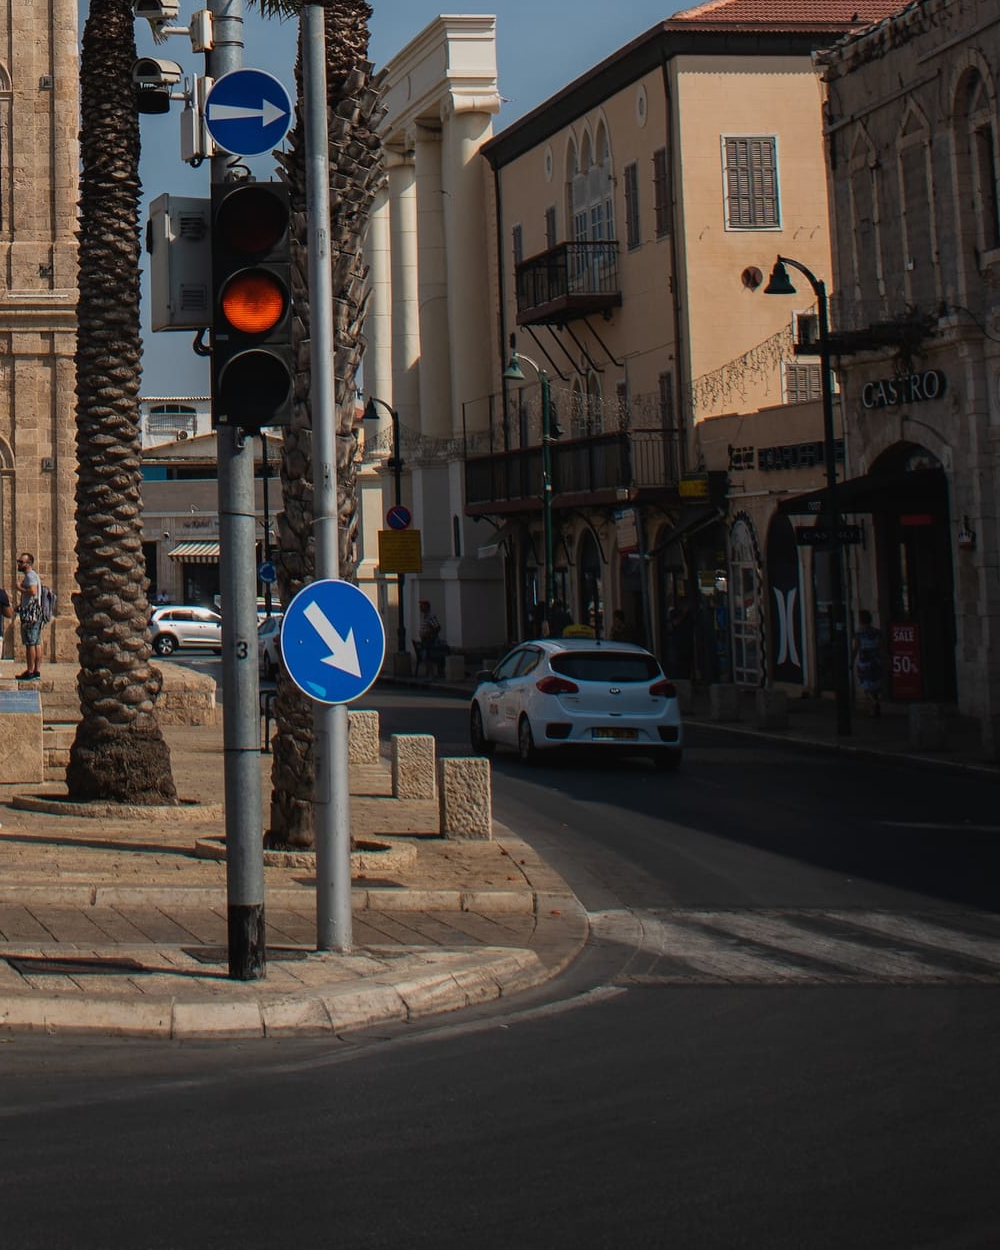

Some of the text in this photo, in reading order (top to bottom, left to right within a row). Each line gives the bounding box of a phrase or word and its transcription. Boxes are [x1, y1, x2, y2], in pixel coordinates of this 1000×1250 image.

[862, 370, 942, 408] CASTRO
[892, 630, 914, 642] SALE
[236, 641, 248, 659] 3
